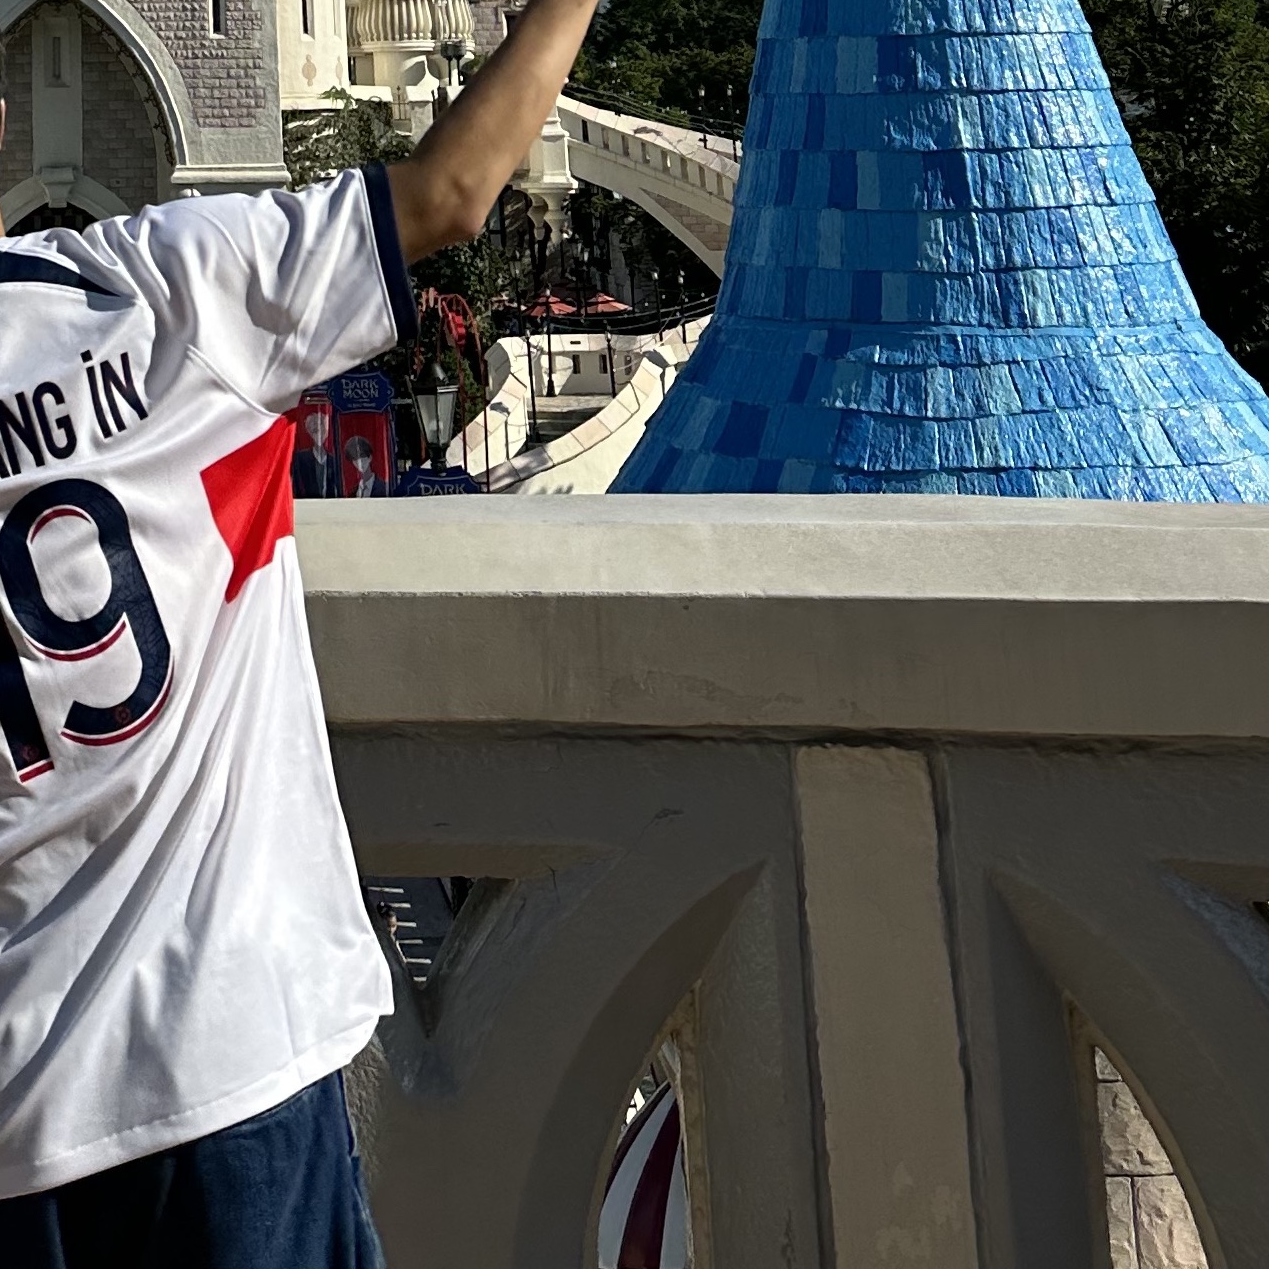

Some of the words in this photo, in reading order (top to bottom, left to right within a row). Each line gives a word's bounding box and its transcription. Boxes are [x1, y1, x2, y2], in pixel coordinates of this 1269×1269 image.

[341, 378, 379, 389] DARK
[342, 388, 379, 399] MOON
[418, 482, 467, 496] DARK
